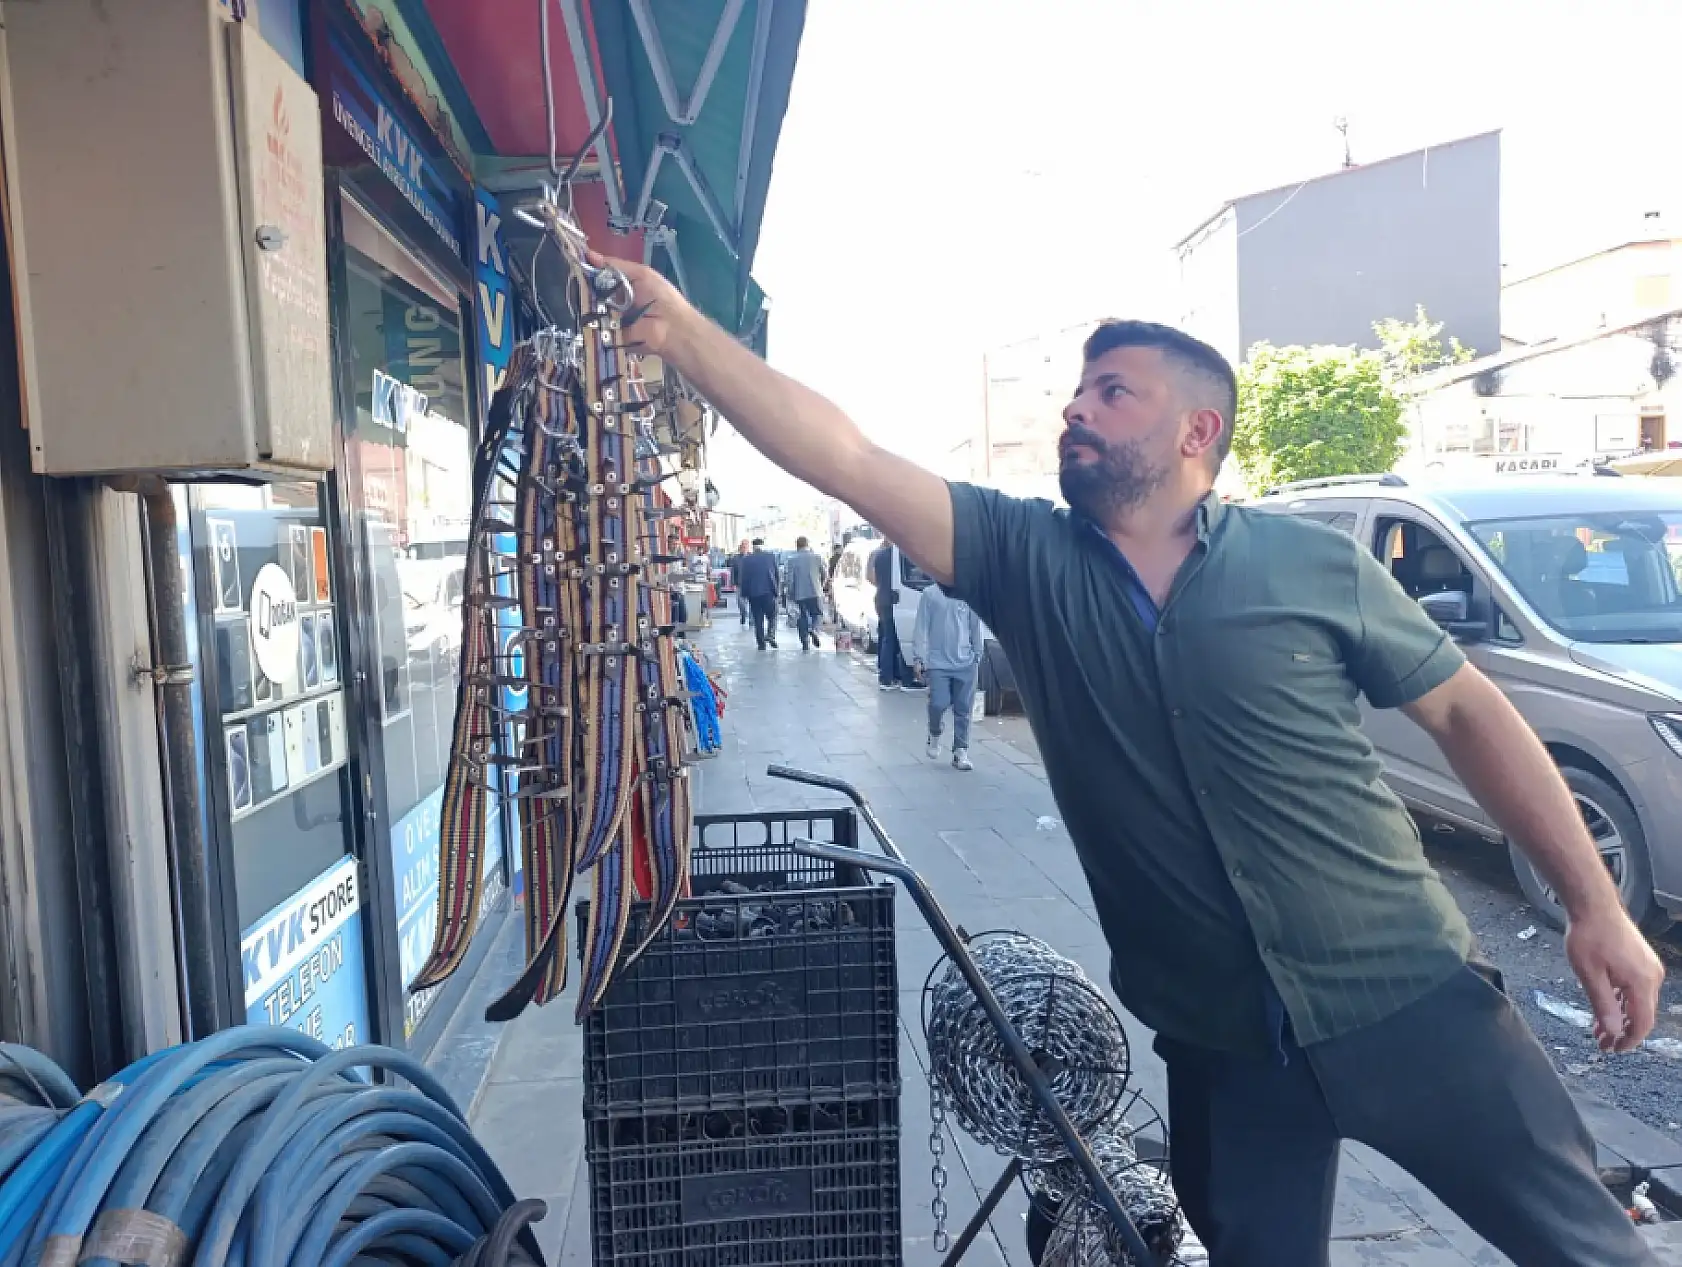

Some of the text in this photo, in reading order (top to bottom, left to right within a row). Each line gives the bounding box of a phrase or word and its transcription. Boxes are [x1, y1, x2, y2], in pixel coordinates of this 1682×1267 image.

[377, 103, 424, 190] KVK
[241, 874, 354, 990] KVK STORE
[264, 929, 343, 1026] TELEFON
